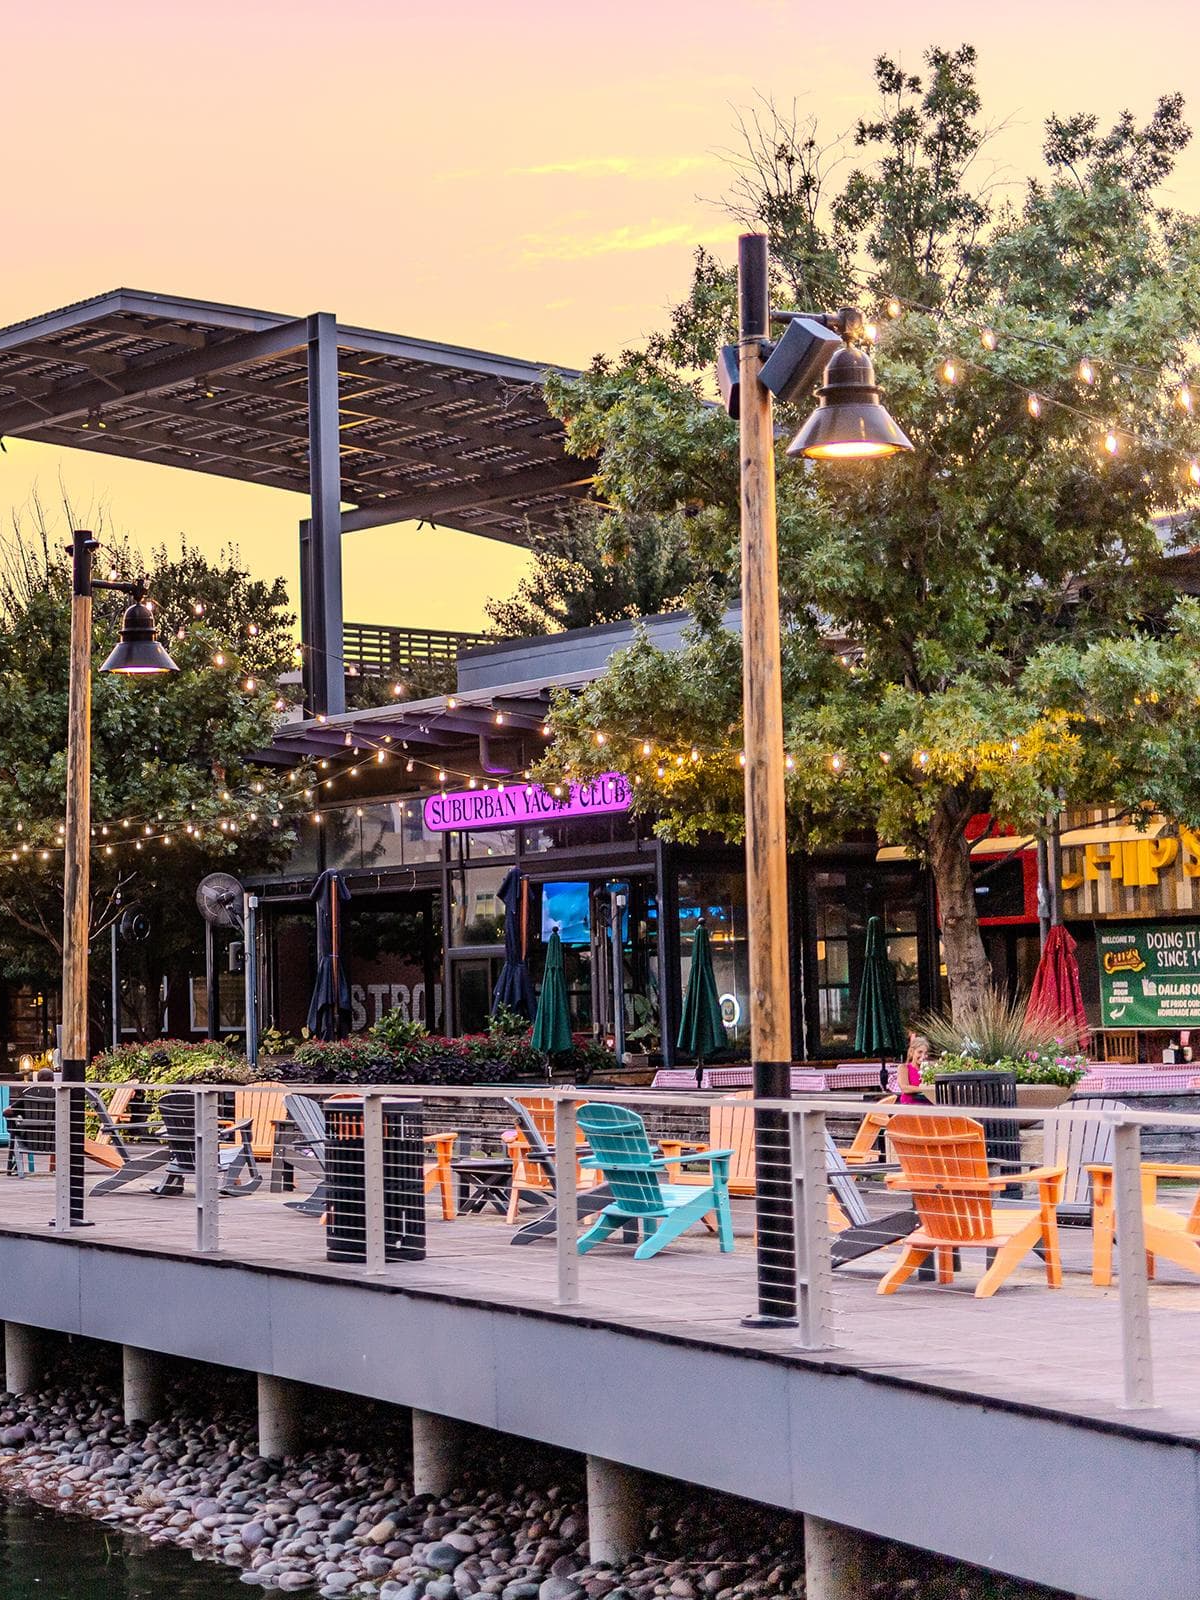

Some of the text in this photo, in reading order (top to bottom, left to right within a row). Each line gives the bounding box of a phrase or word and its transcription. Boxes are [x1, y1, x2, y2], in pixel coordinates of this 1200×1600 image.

[431, 791, 517, 825] SUBURBAN
[579, 779, 626, 808] CLUB
[1128, 935, 1136, 943] TO
[1146, 931, 1196, 949] DOING IT
[1157, 950, 1189, 967] SINCE
[1158, 984, 1190, 996] DALLAS
